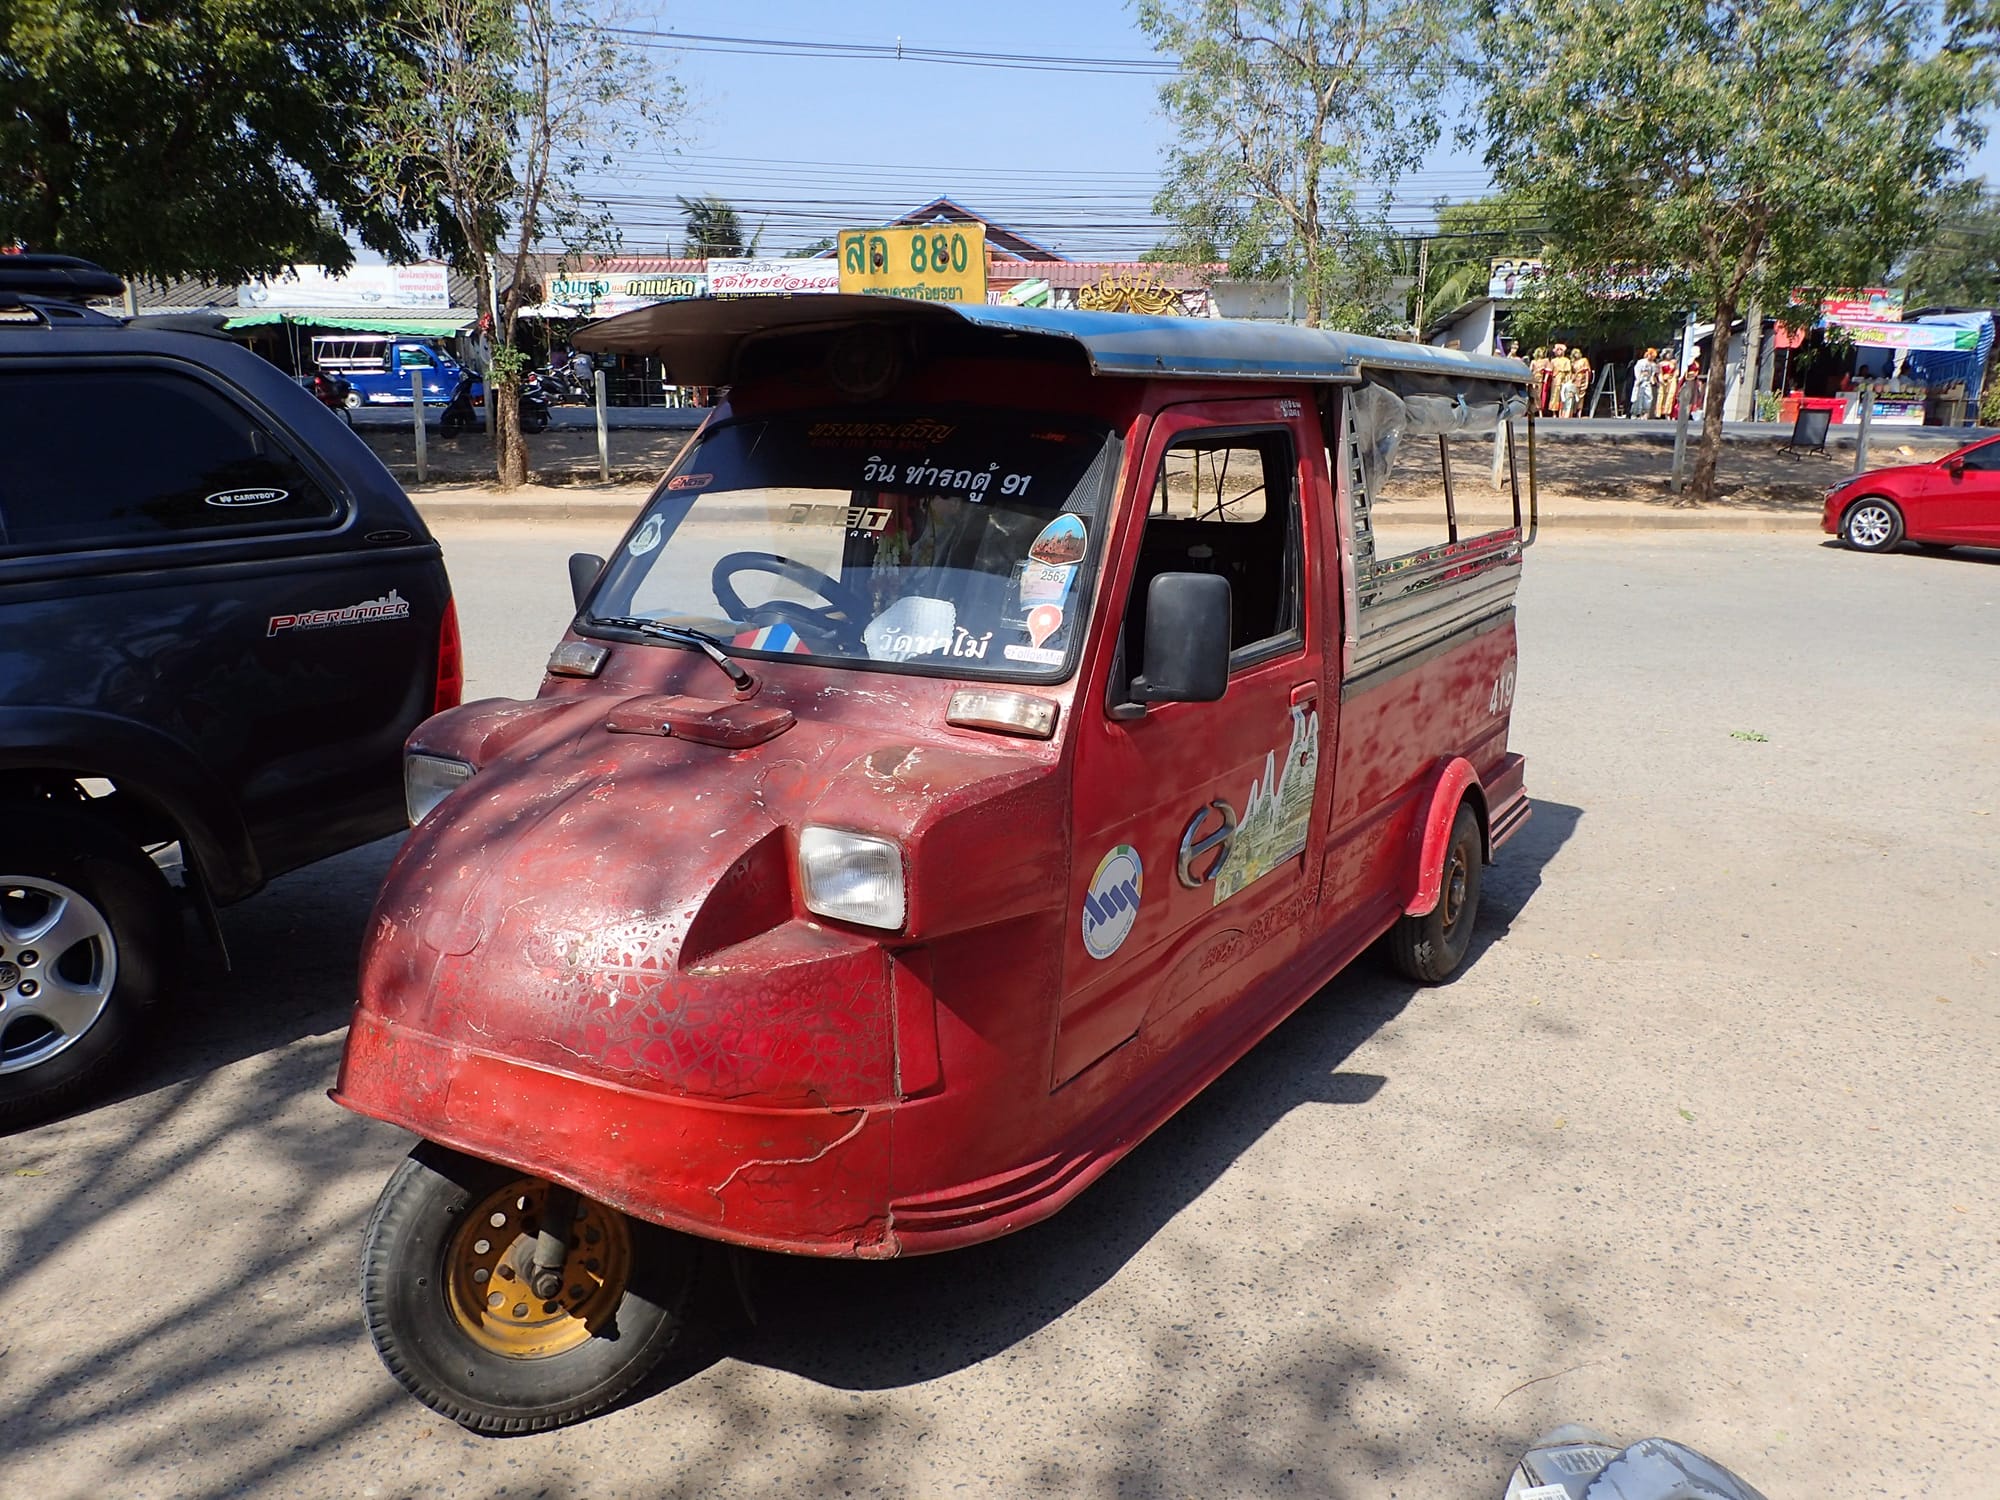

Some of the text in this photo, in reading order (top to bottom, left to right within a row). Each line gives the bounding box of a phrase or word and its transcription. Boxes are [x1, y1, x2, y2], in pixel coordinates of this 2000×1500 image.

[911, 233, 968, 273] 880
[625, 277, 695, 296] กาแฟสด
[864, 455, 1033, 502] วิน ท่ารถตู้ 91
[233, 492, 276, 502] CARRYBOY
[1040, 571, 1066, 584] 2562
[267, 602, 409, 637] PRERUNNER
[880, 626, 993, 659] วัดท่าไม้
[1489, 671, 1514, 716] 419
